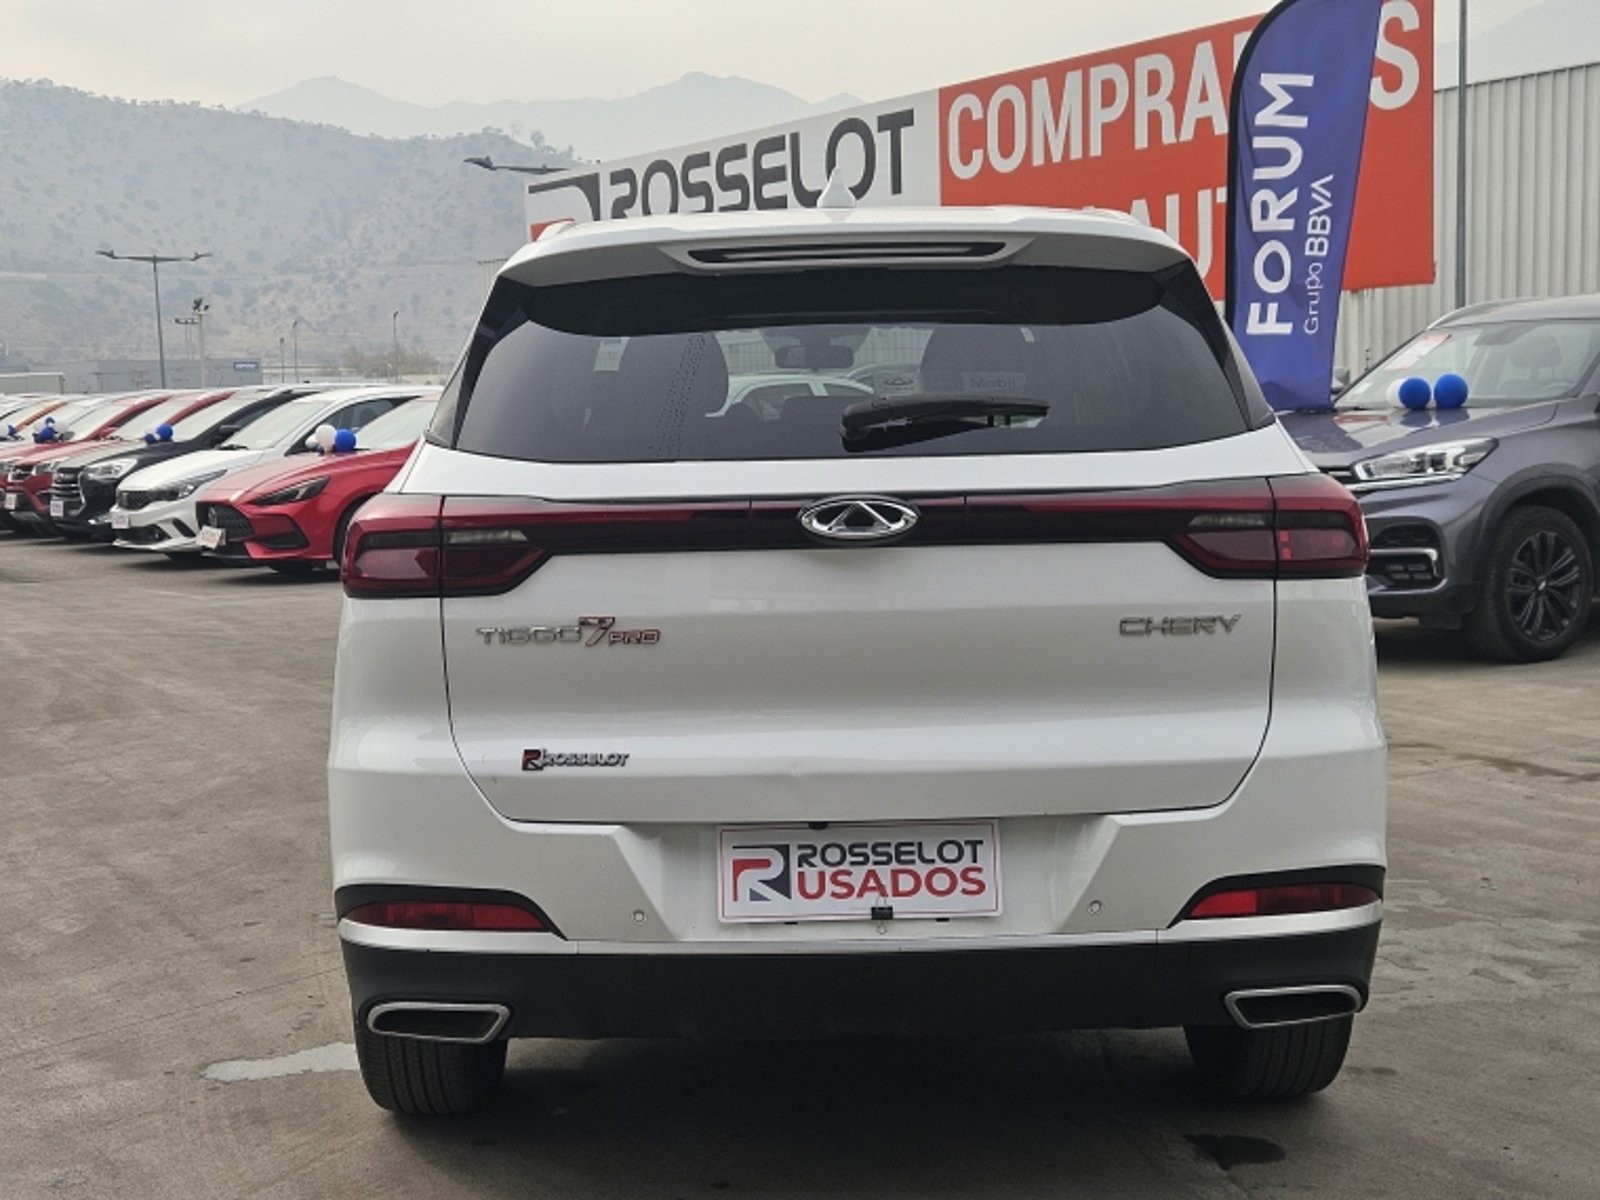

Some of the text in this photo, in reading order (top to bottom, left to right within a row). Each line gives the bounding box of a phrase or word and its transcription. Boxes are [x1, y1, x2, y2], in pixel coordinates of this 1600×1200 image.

[948, 0, 1420, 180] COMPRAS
[609, 108, 914, 220] ROSSELOT
[1246, 72, 1314, 336] FORUM
[1303, 174, 1334, 335] Grupo BBVA
[1120, 614, 1242, 636] CHERY
[797, 839, 984, 868] ROSSELOT
[797, 867, 987, 900] USADOS
